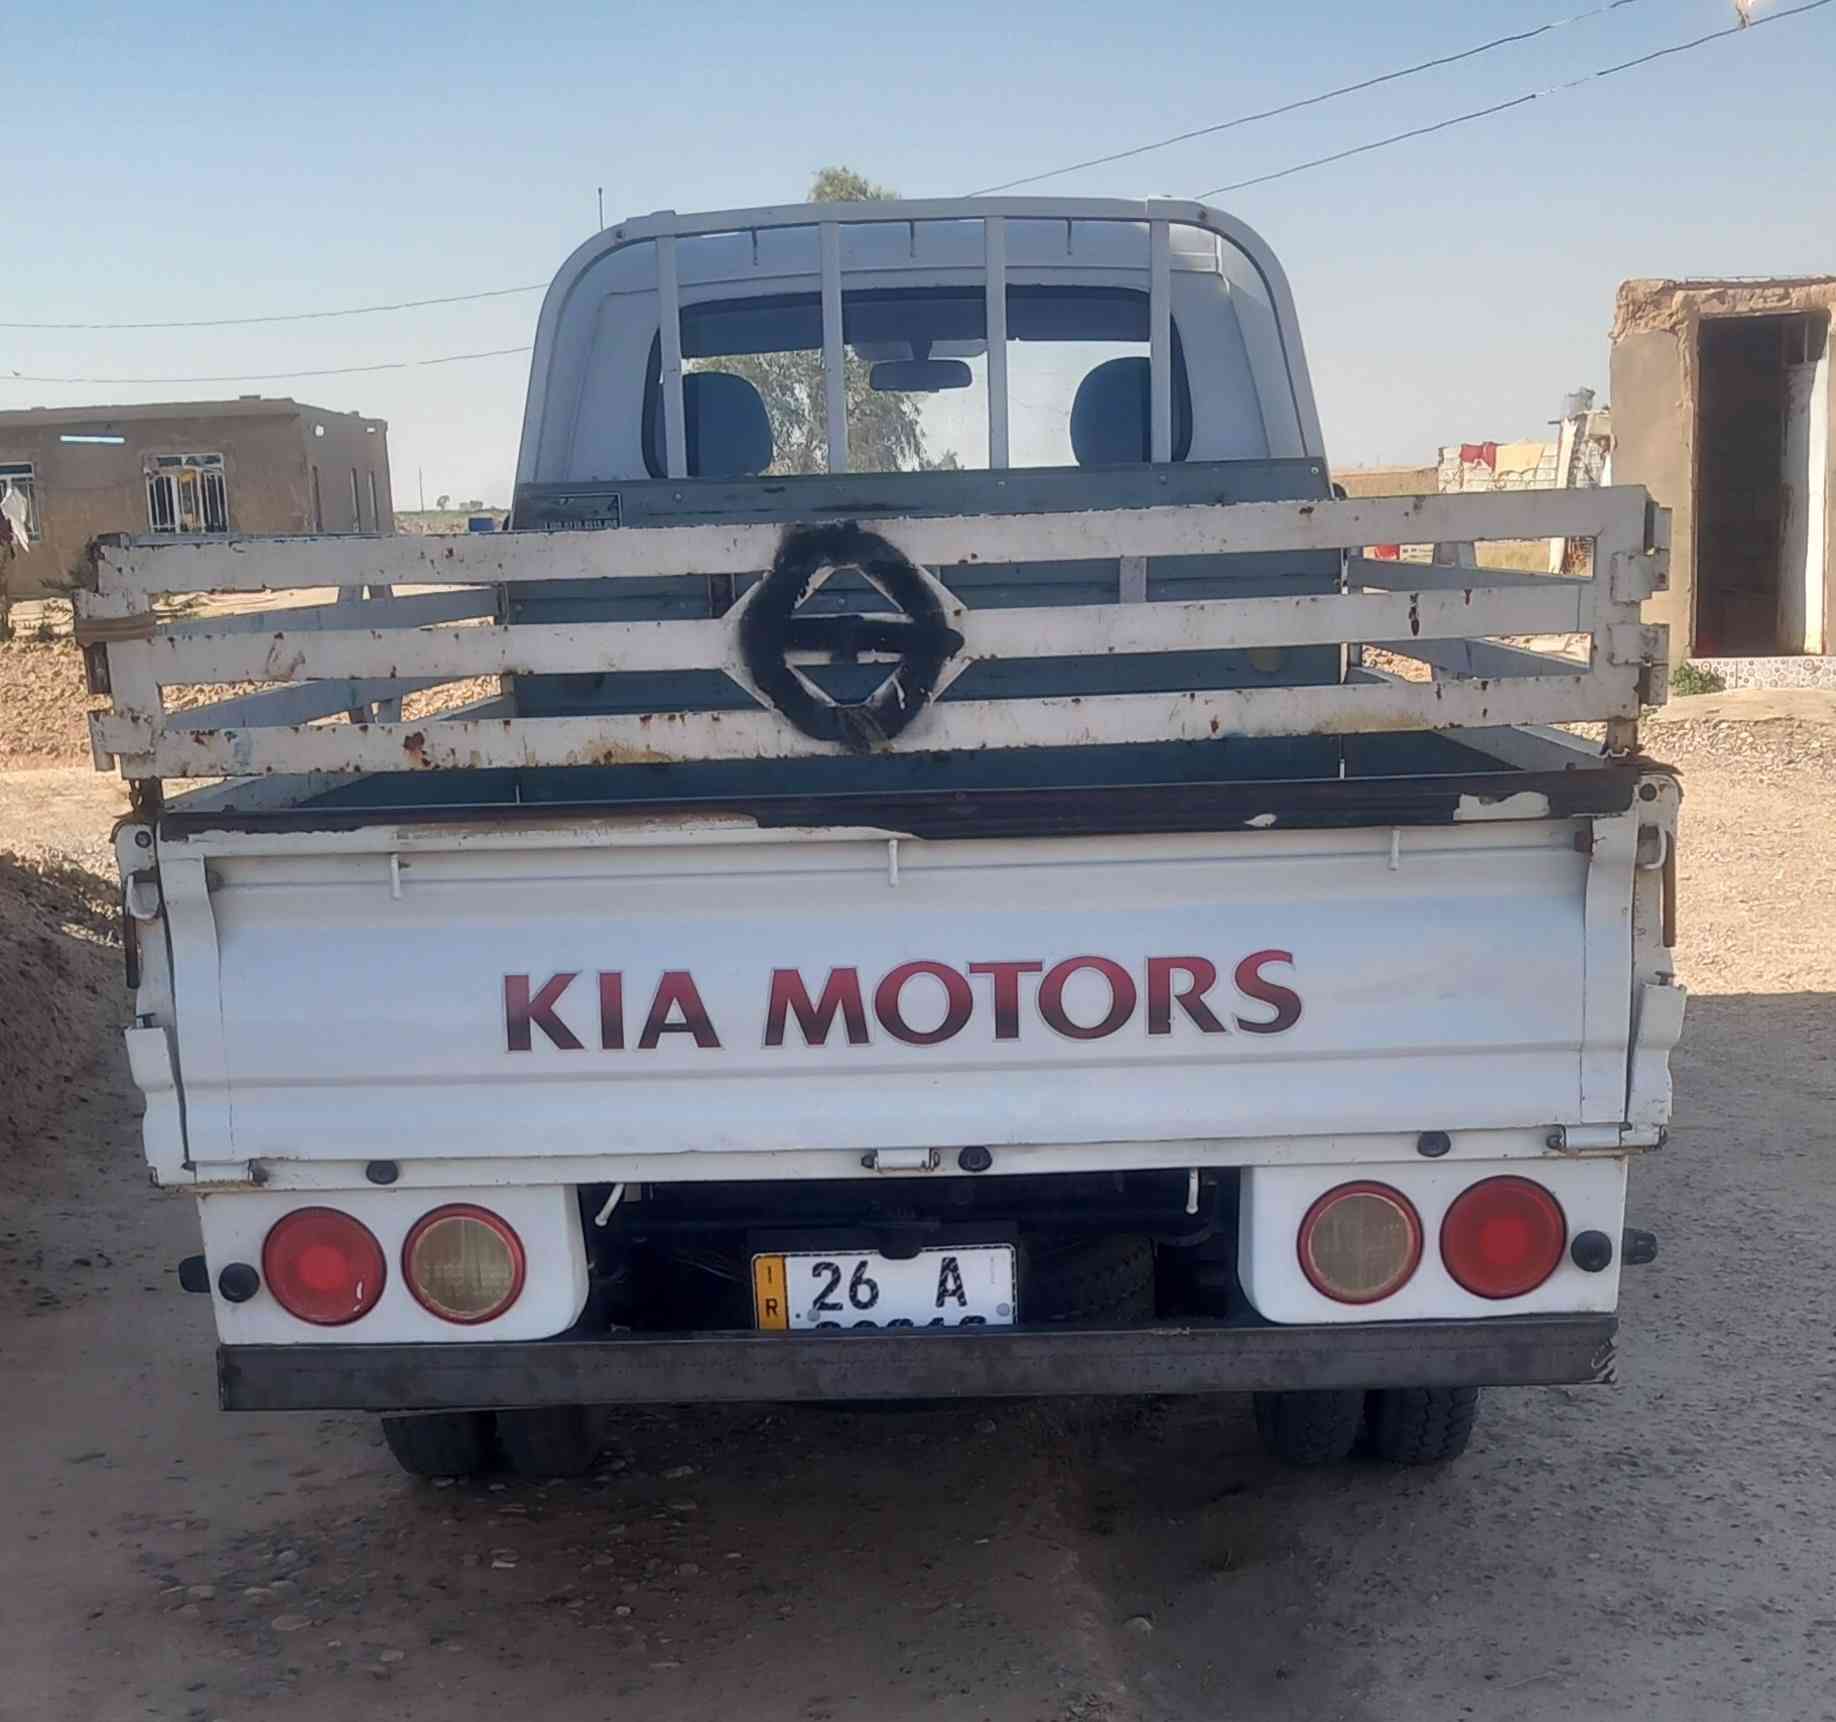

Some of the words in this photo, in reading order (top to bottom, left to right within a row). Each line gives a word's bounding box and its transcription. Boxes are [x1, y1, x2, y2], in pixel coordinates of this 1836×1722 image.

[503, 970, 723, 1051] KIA
[761, 949, 1303, 1047] MOTORS
[811, 1260, 880, 1311] 26
[935, 1256, 968, 1308] A
